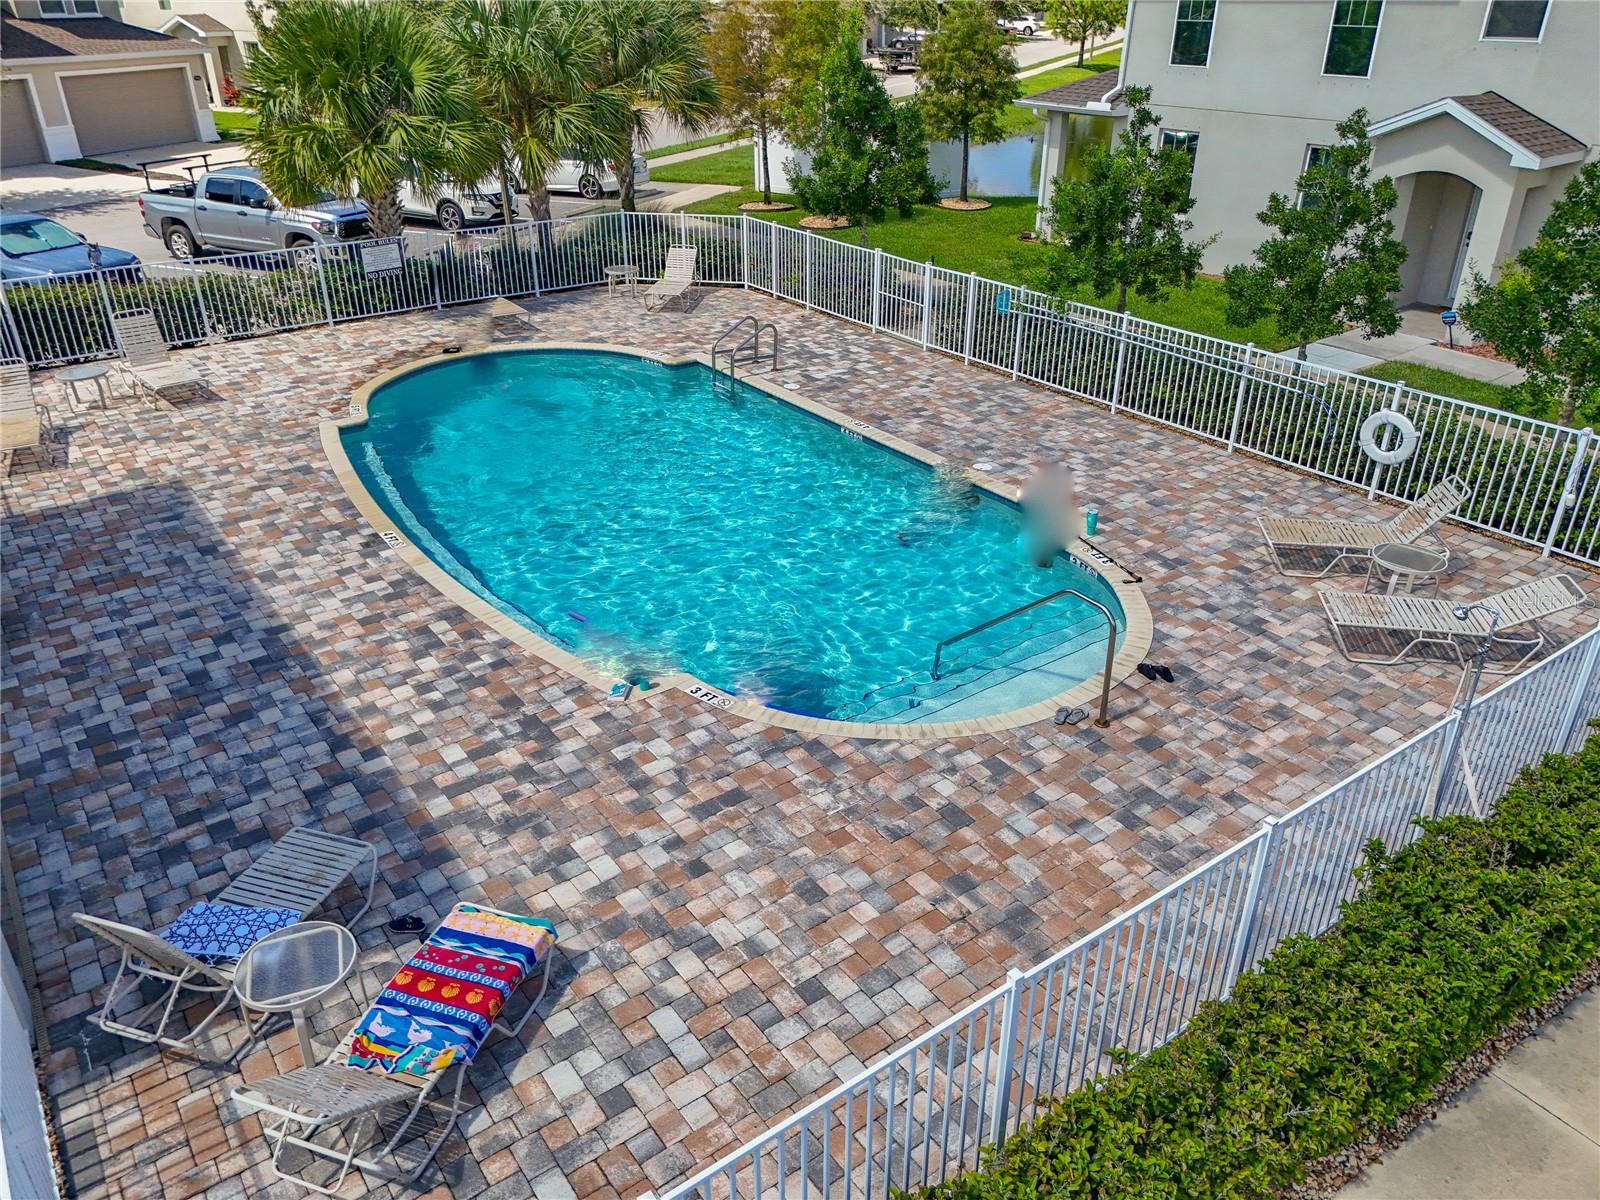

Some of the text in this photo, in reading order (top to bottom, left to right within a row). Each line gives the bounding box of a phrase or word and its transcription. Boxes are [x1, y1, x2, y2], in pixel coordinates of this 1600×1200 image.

[367, 268, 403, 280] NO DIVING
[385, 535, 399, 543] FT
[1072, 557, 1089, 572] 3 FT
[690, 686, 719, 702] 3 FT
